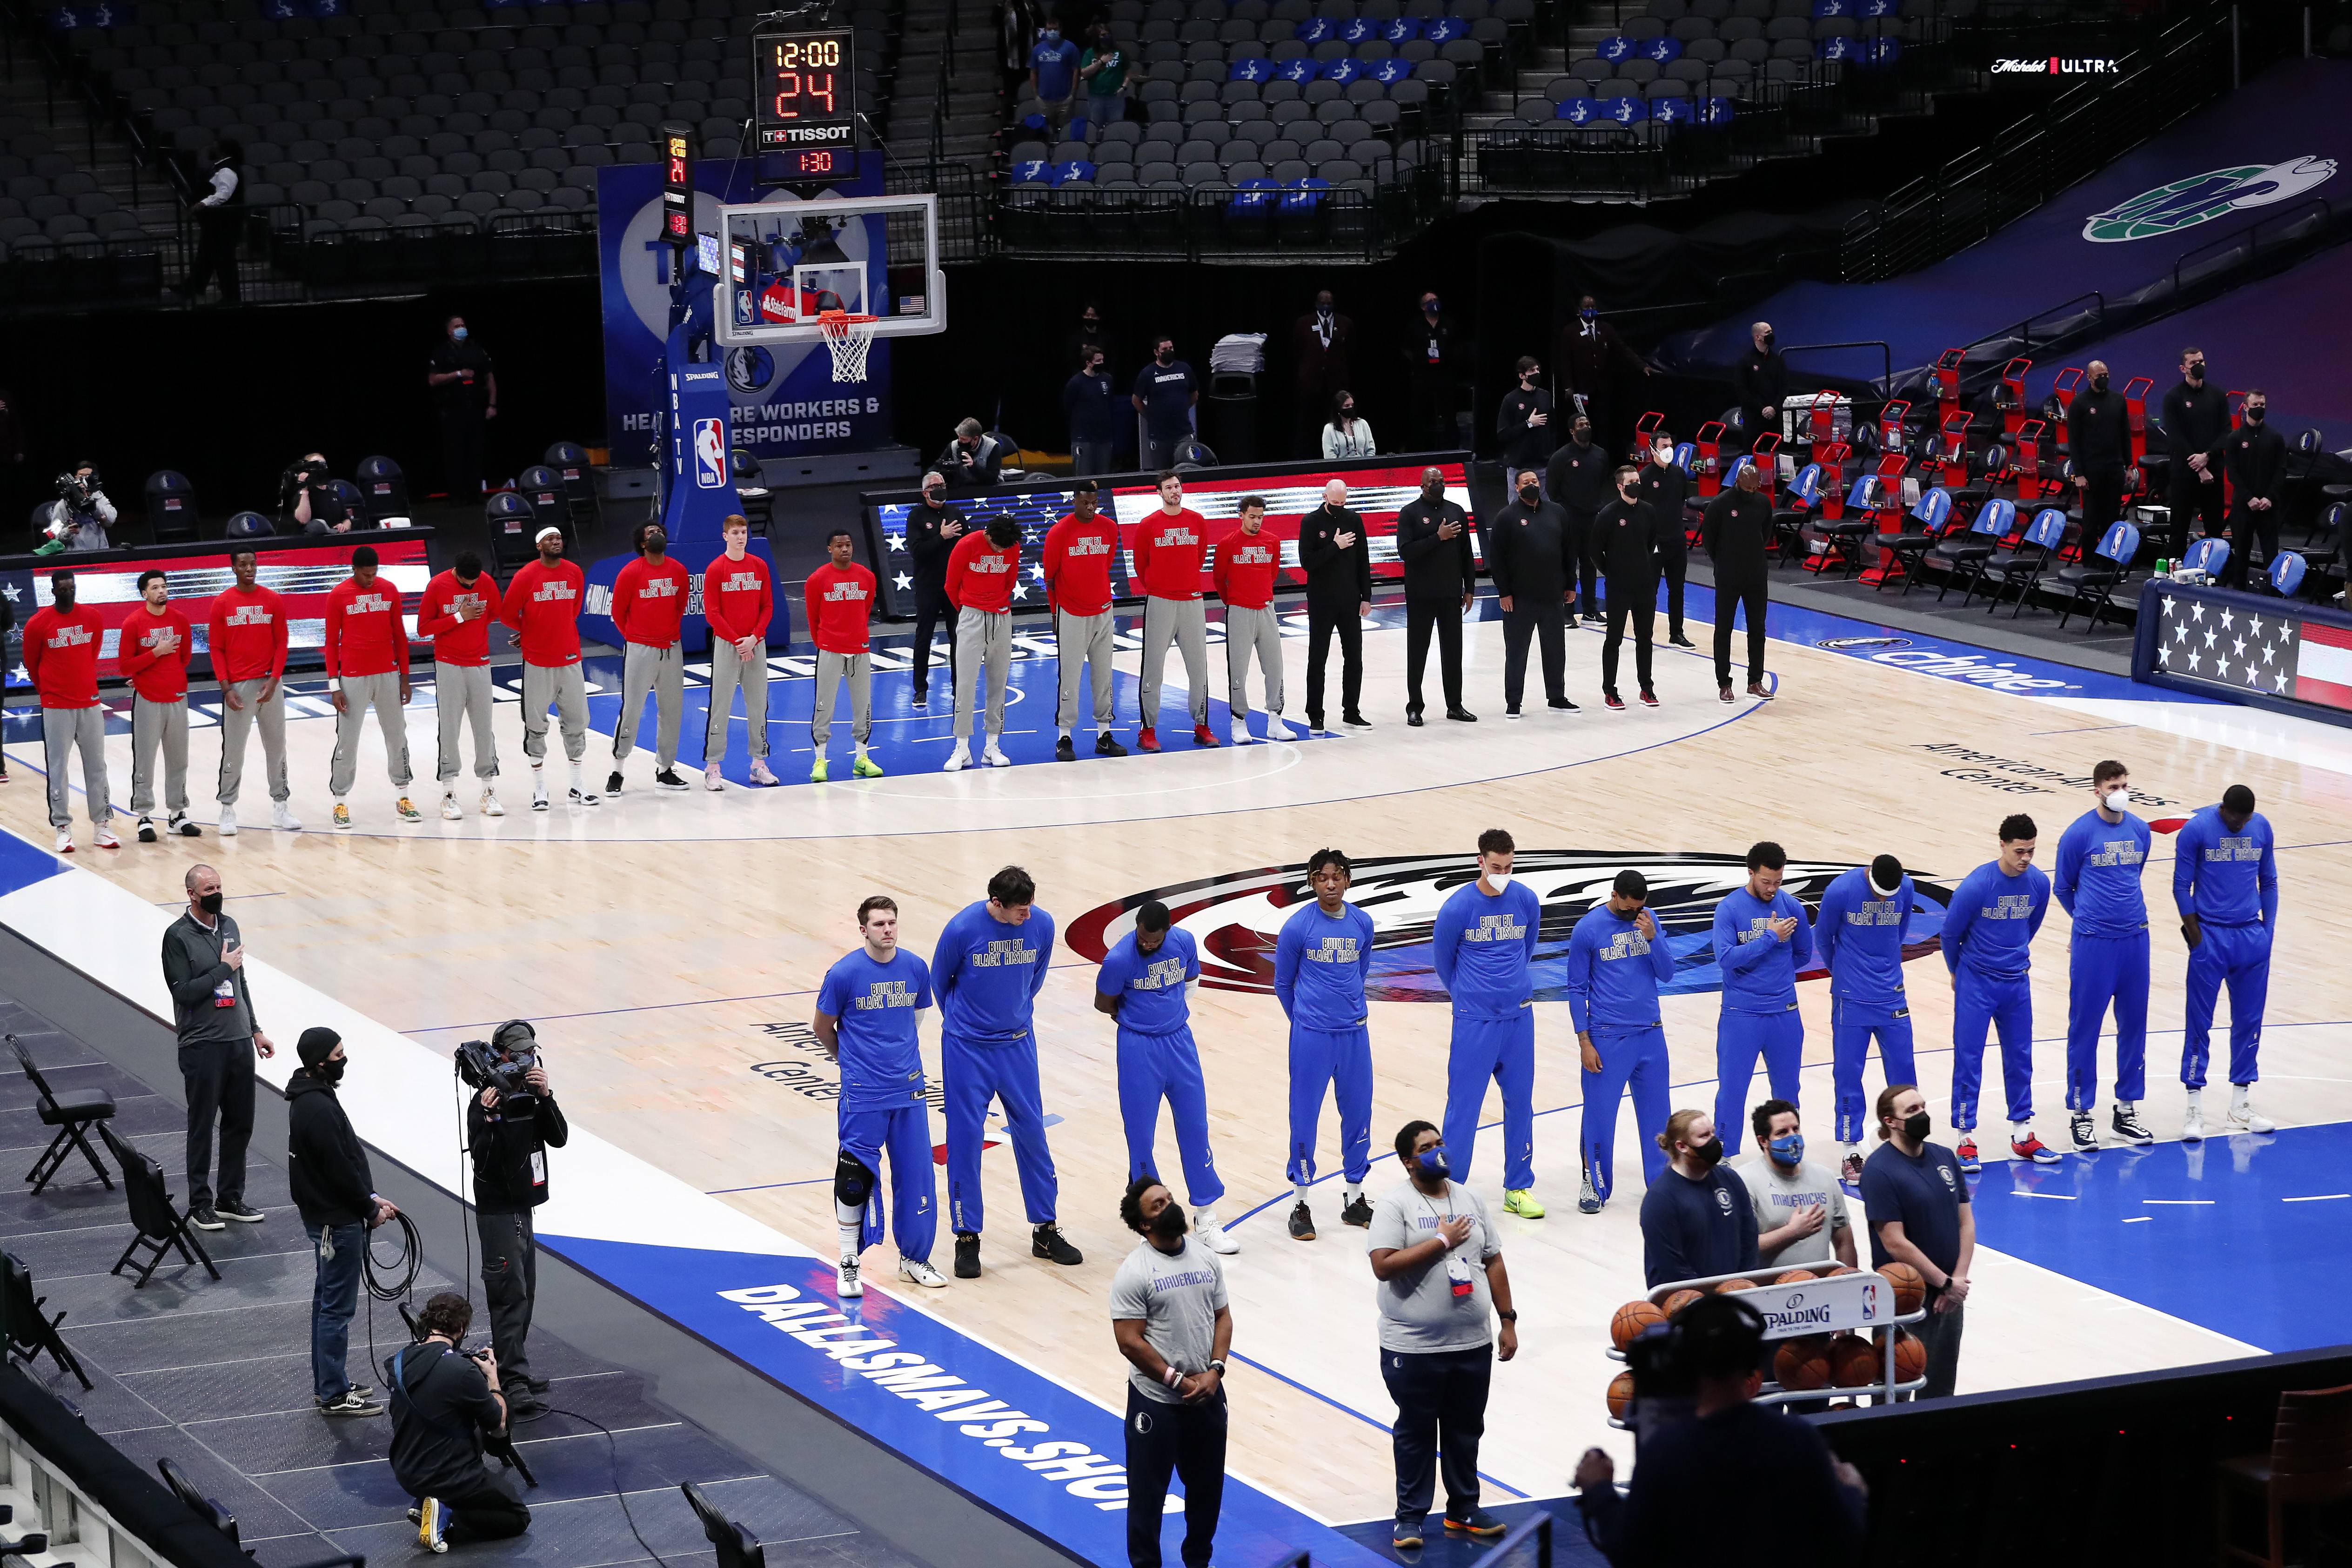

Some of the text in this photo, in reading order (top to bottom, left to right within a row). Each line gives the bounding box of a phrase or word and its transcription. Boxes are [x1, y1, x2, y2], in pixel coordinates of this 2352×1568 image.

[777, 40, 839, 68] 12:00
[1991, 59, 2119, 74] Michelob ULTRA
[776, 72, 833, 117] 24
[787, 127, 851, 141] TISSOT
[801, 152, 831, 172] 1:30
[685, 371, 719, 381] SPALDING
[1154, 372, 1186, 383] MAVERICKS
[760, 398, 860, 421] WORKERS
[866, 397, 879, 413] &
[731, 421, 851, 445] ESPONDERS
[701, 472, 716, 484] NBA
[1164, 527, 1189, 537] BUILT BY
[1078, 536, 1101, 546] BUILT BY
[1154, 537, 1174, 547] BLACK
[1068, 545, 1088, 556] BLACK
[1242, 546, 1266, 555] BUILT BY
[996, 555, 1005, 564] BY
[1233, 554, 1252, 564] BLACK
[969, 563, 988, 573] BLACK
[648, 578, 672, 589] BUILT BY
[731, 573, 746, 582] BUILT
[543, 581, 567, 590] BUILT BY
[722, 581, 741, 592] BLACK
[833, 582, 859, 591] BUILT BY
[356, 594, 382, 604] BUILT BY
[470, 593, 479, 602] BY
[533, 591, 553, 602] BLACK
[639, 588, 658, 598] BLACK
[824, 591, 844, 601] BLACK
[237, 606, 263, 616] BUILT BY
[347, 603, 367, 615] BLACK
[227, 615, 247, 626] BLACK
[57, 625, 83, 637] BUILT BY
[165, 626, 174, 635] BY
[48, 636, 69, 648] BLACK
[1909, 743, 2065, 779] American
[1940, 768, 2057, 794] Center
[2104, 840, 2135, 855] BUILT BY
[2219, 837, 2252, 850] BUILT BY
[2091, 852, 2118, 867] BLACK
[2205, 848, 2232, 861] BLACK
[1862, 901, 1896, 913] BUILT BY
[1997, 895, 2030, 909] BUILT BY
[1847, 911, 1873, 925] BLACK
[1982, 907, 2008, 920] BLACK
[1480, 914, 1514, 928] BUILT BY
[1465, 928, 1492, 942] BLACK
[1612, 933, 1635, 946] BUILT
[987, 938, 1024, 953] BUILT BY
[1322, 937, 1357, 951] BUILT BY
[972, 948, 1037, 967] BLACK HISTORY
[1307, 949, 1333, 963] BLACK
[1599, 948, 1628, 961] BLACK
[1147, 957, 1180, 978] BUILT BY
[870, 980, 905, 996] BUILT BY
[1133, 976, 1162, 990] BLACK
[855, 995, 885, 1011] BLACK
[1595, 1160, 1605, 1188] MAVERICKS
[1154, 1269, 1214, 1293] MAVERICKS
[1762, 1304, 1830, 1329] SPALDING
[716, 1283, 1185, 1513] DALLASMAVS.SHO
